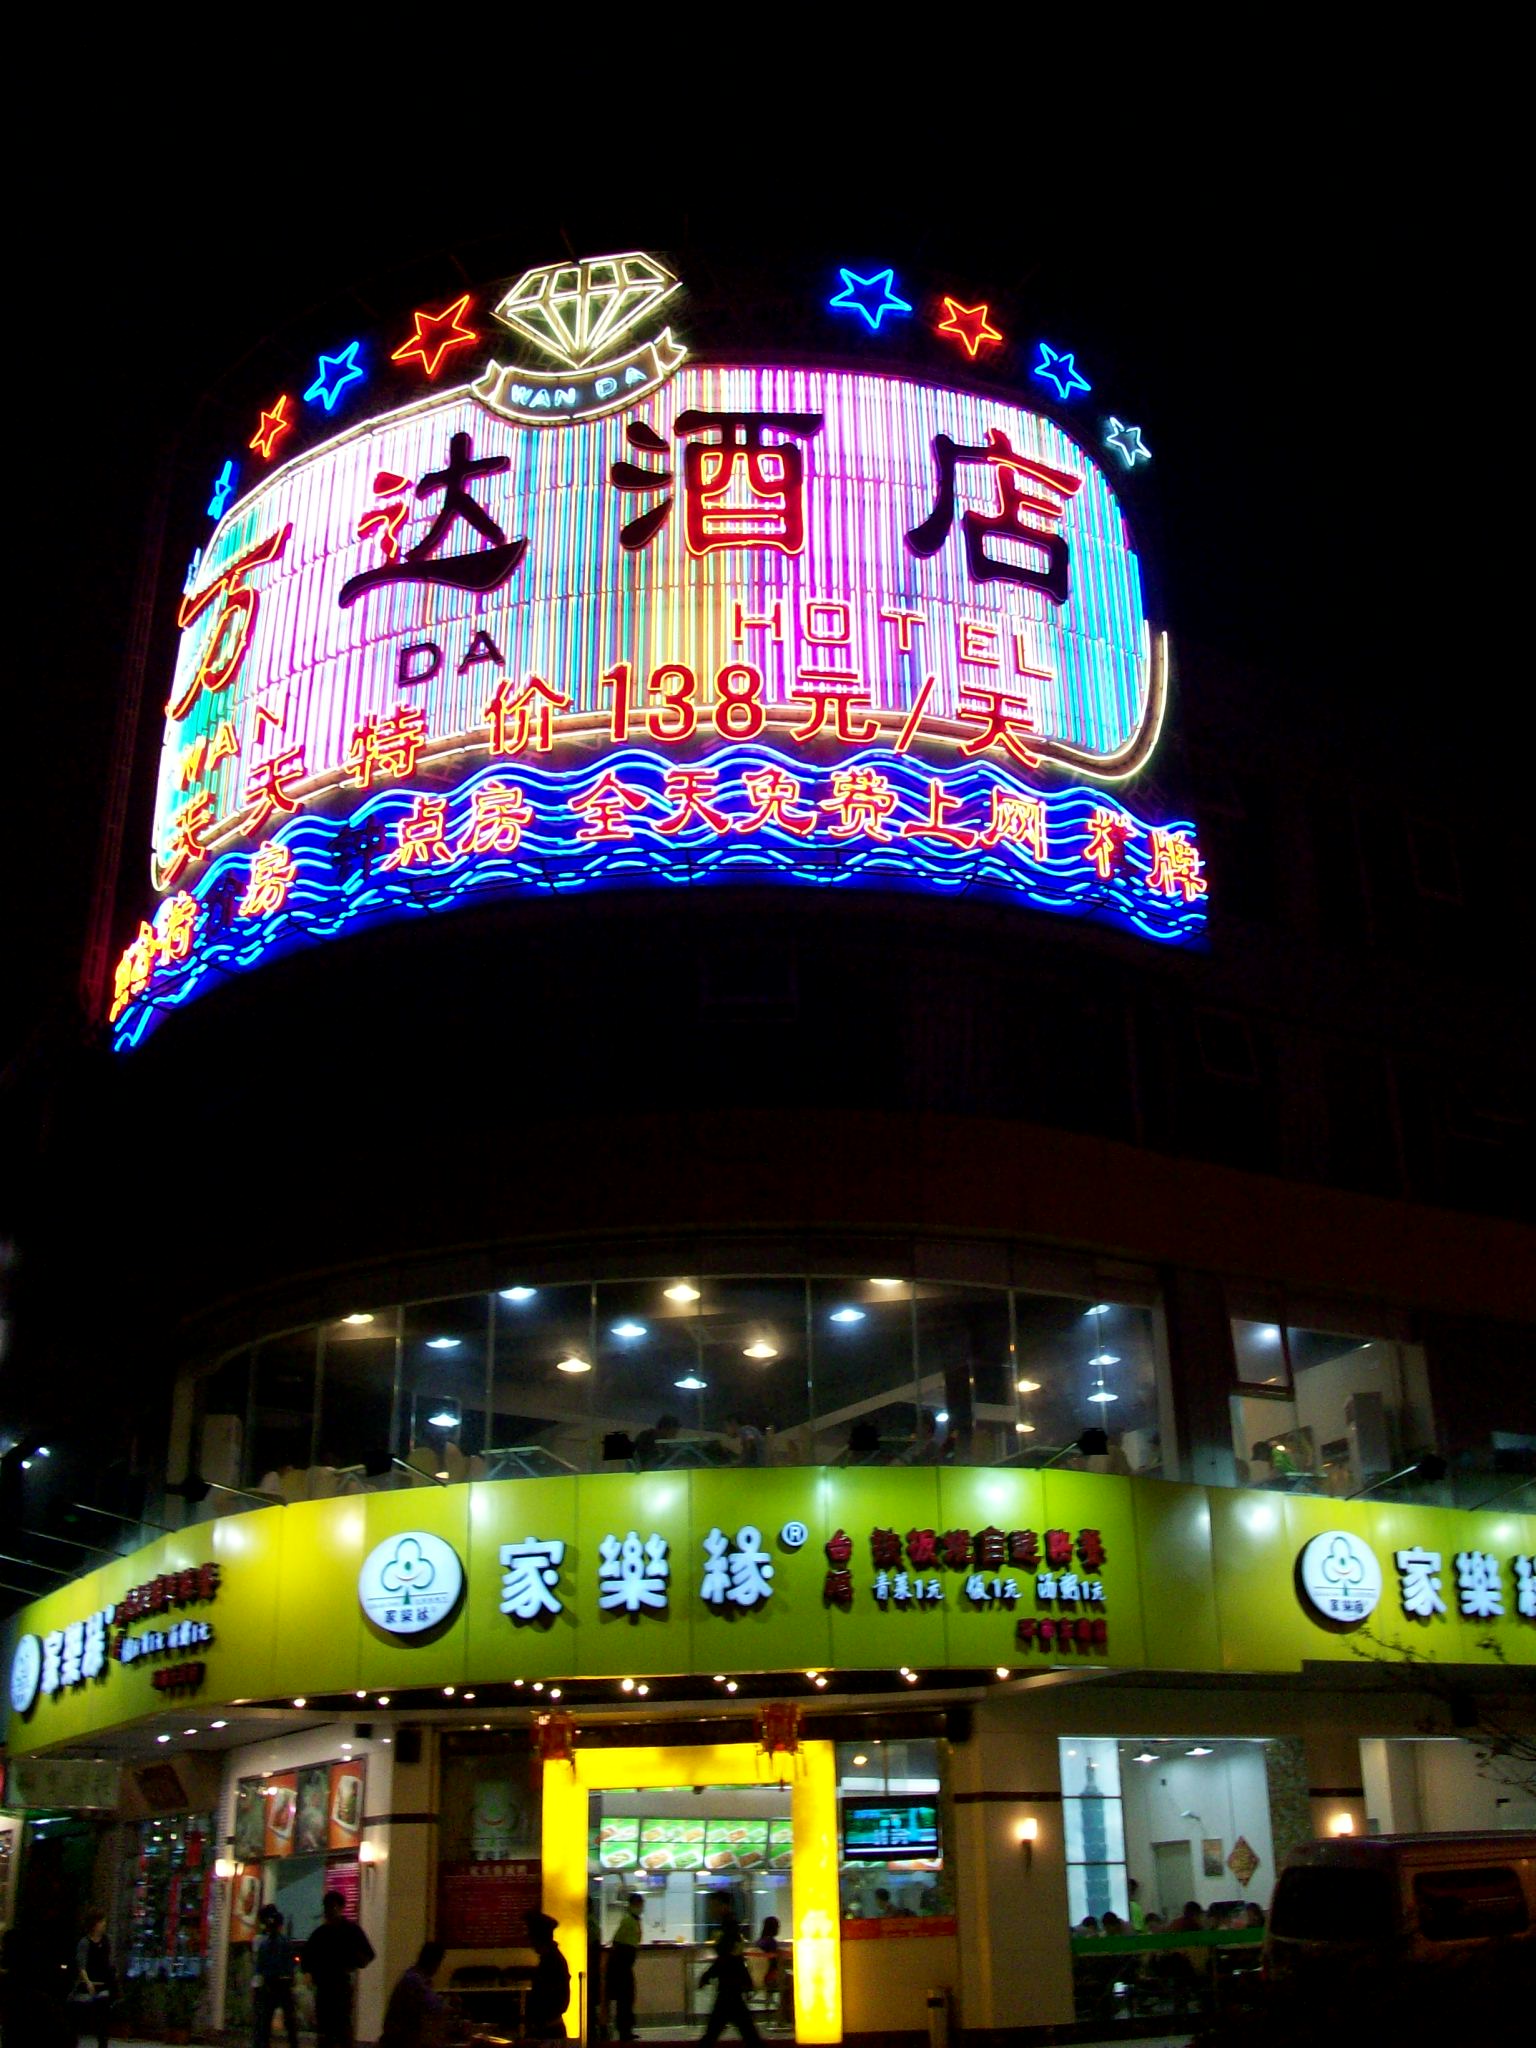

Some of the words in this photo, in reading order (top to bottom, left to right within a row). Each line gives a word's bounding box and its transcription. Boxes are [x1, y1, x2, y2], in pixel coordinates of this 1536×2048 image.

[511, 384, 576, 409] WAN
[594, 366, 648, 399] DA
[164, 407, 1086, 721] 万达酒店
[399, 628, 506, 687] DA
[732, 598, 1057, 680] HOTEL
